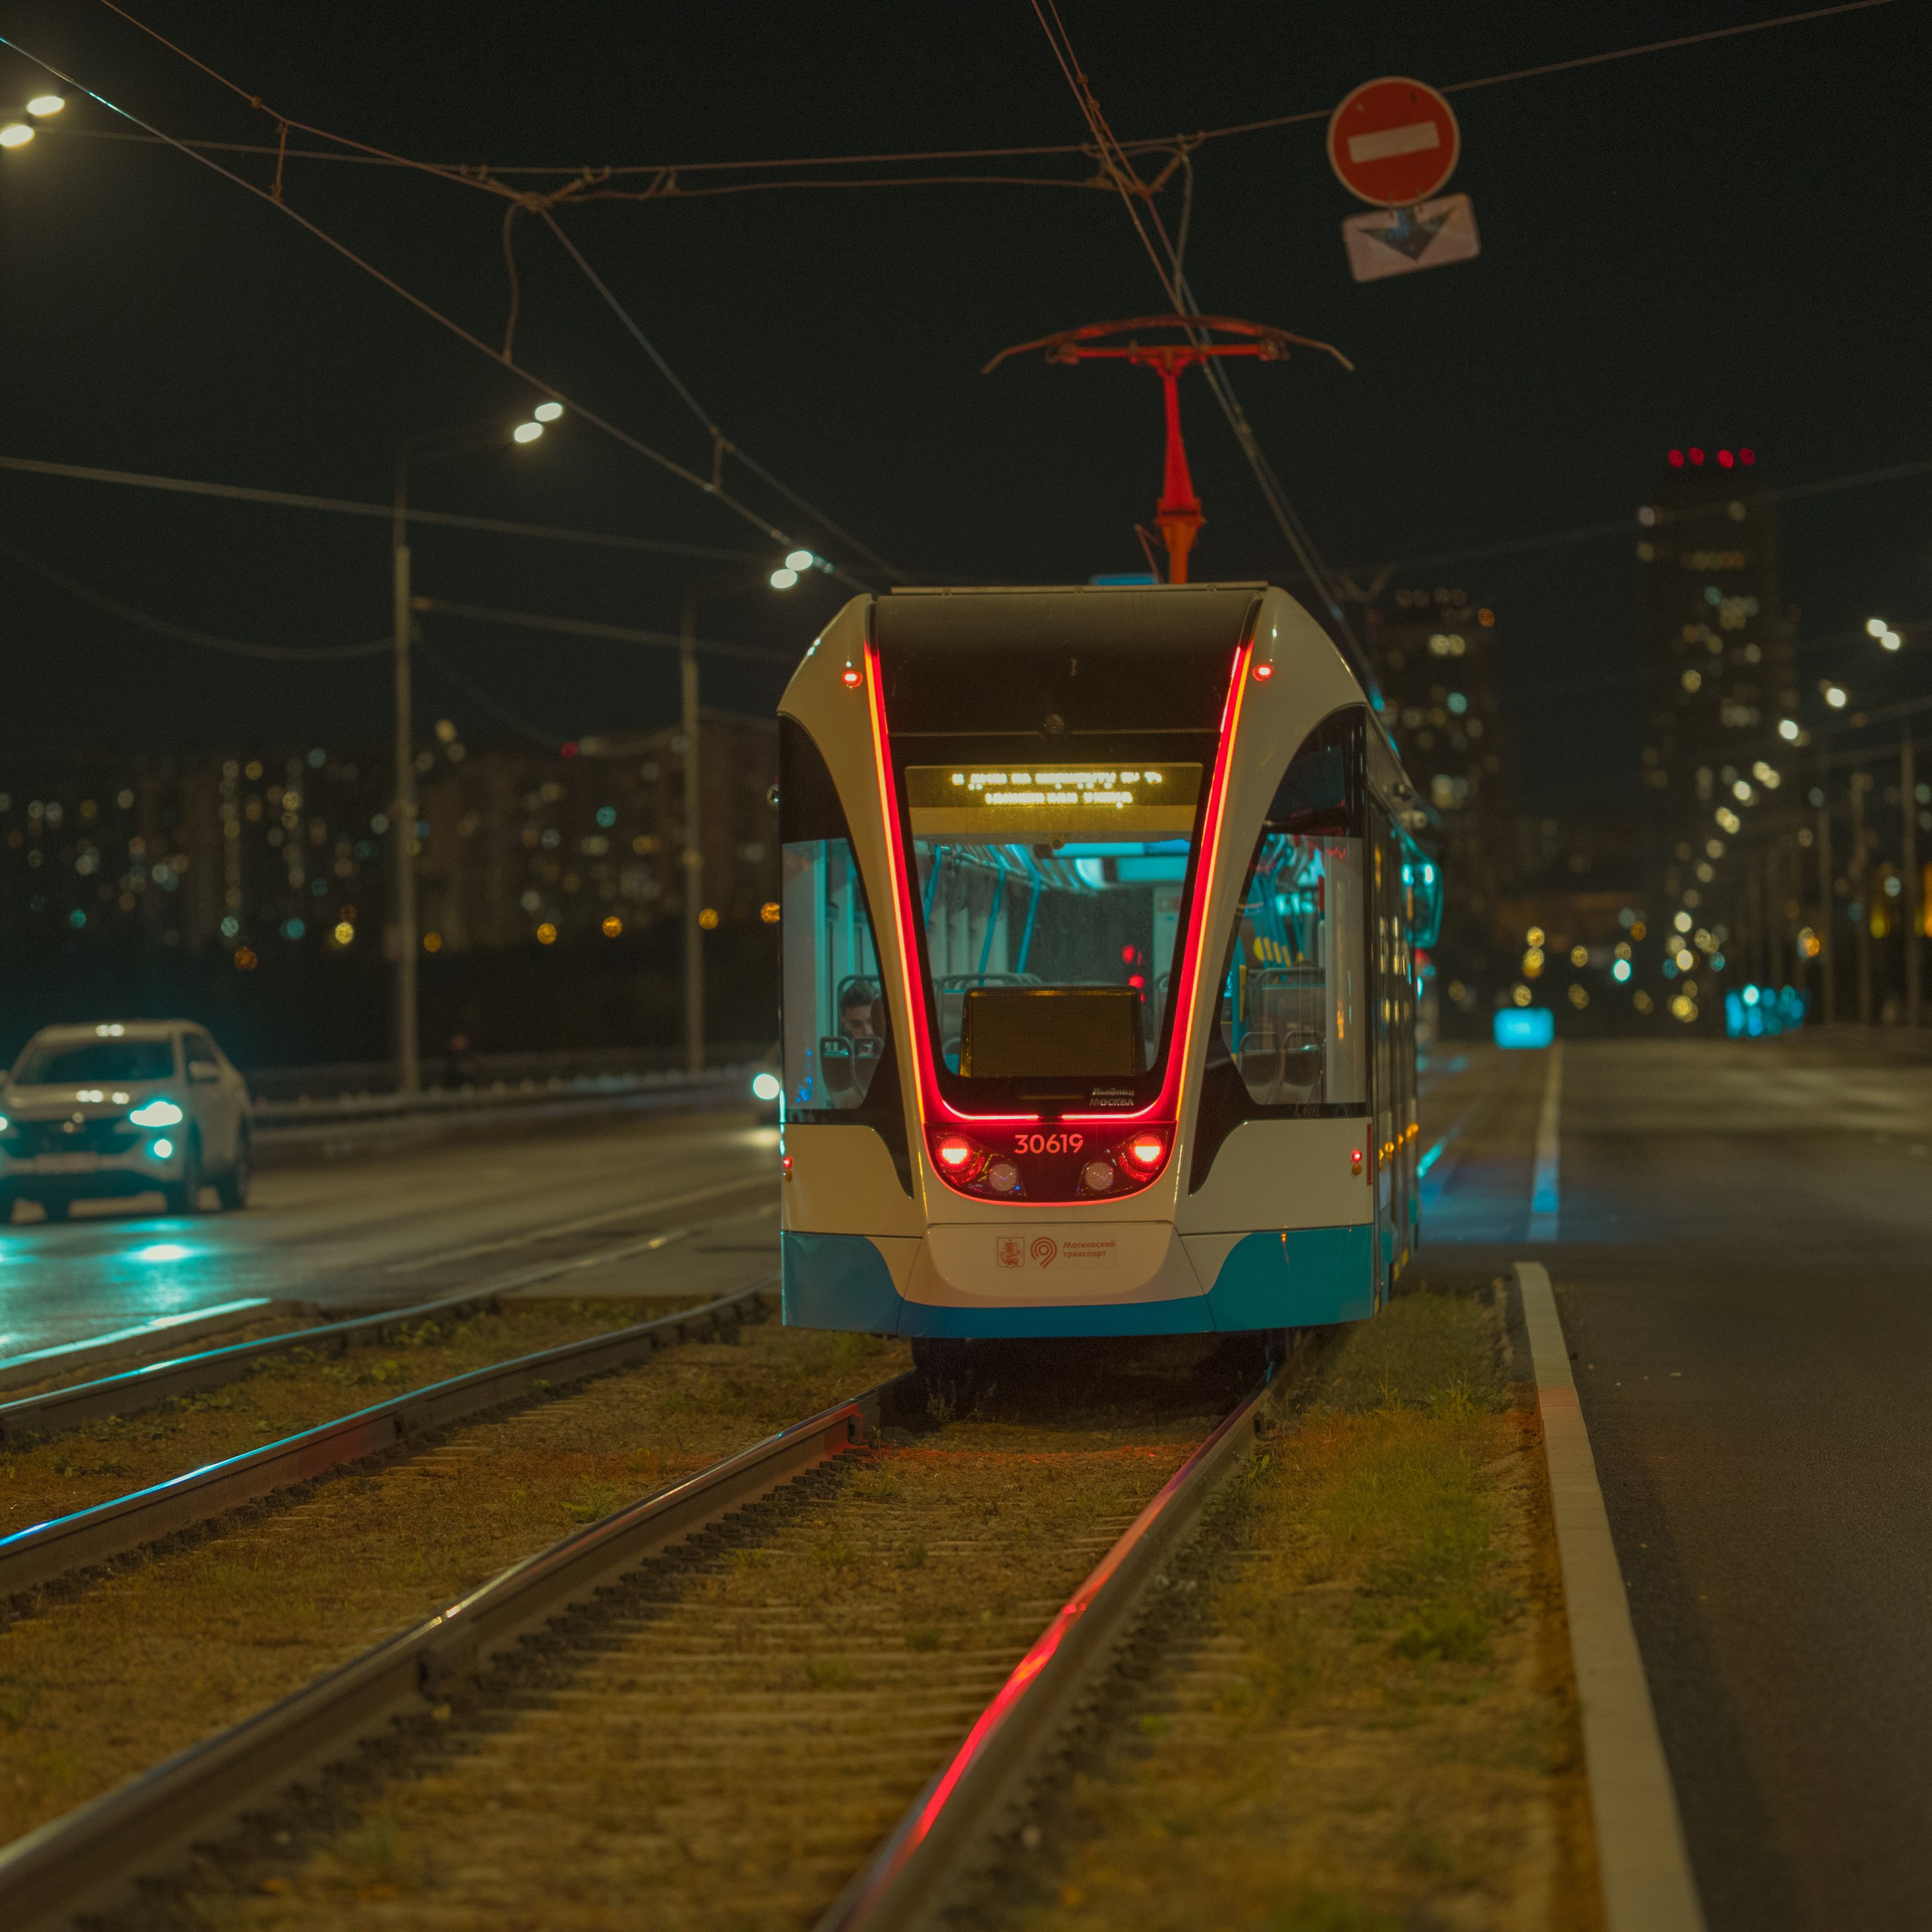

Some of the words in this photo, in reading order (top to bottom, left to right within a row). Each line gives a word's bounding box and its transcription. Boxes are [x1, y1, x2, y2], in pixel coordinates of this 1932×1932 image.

[1014, 1134, 1084, 1154] 30619
[1063, 1241, 1115, 1249] Московский
[1063, 1251, 1106, 1259] транспорт
